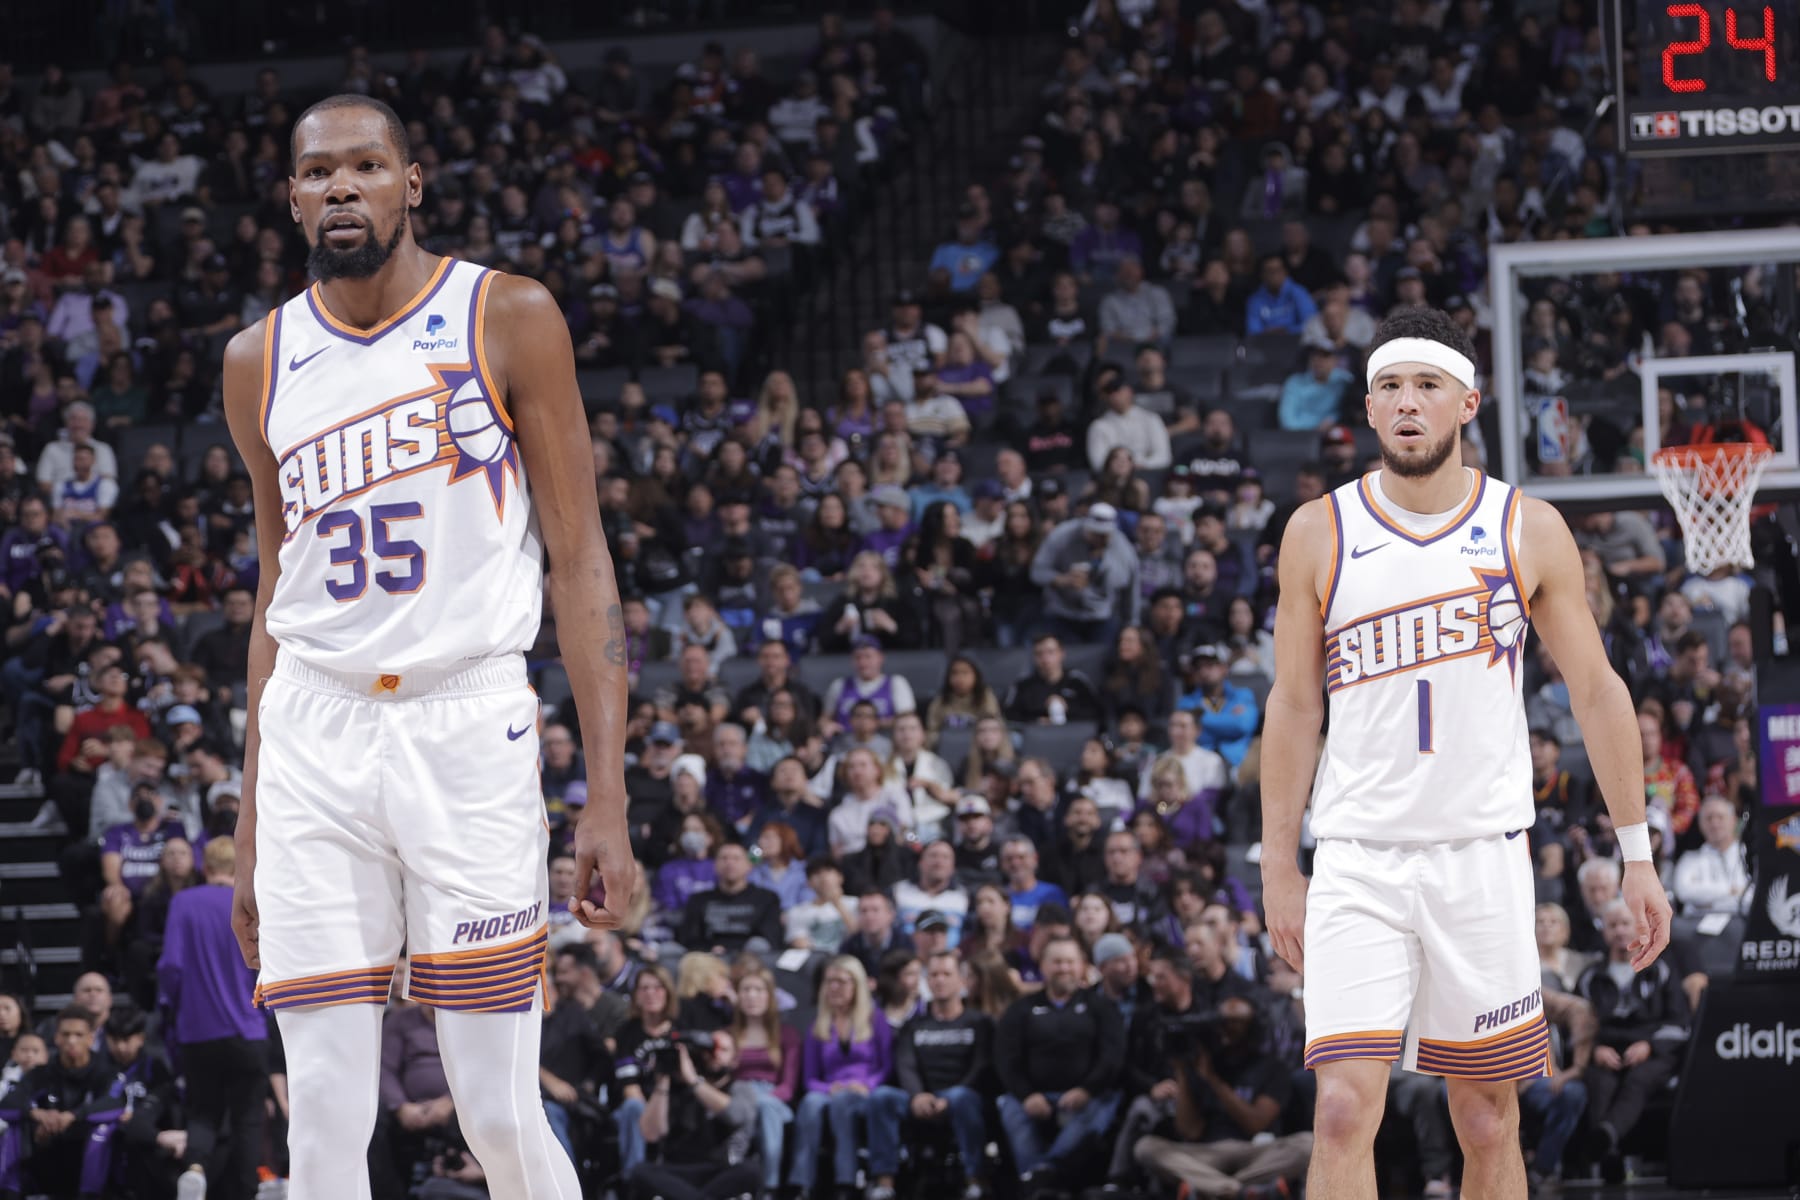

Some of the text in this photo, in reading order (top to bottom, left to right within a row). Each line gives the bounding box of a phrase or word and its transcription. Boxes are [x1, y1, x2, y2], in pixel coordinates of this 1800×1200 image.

[1662, 3, 1776, 93] 24
[1679, 104, 1800, 137] TISSOT
[413, 337, 458, 351] PayPal
[279, 397, 440, 533] SUNS
[316, 501, 427, 603] 35
[1460, 546, 1497, 556] PayPal
[1338, 596, 1480, 685] SUNS
[1416, 679, 1435, 754] 1
[452, 900, 542, 945] PHOENIX
[1473, 986, 1541, 1033] PHOENIX
[1715, 1021, 1800, 1066] dialp
